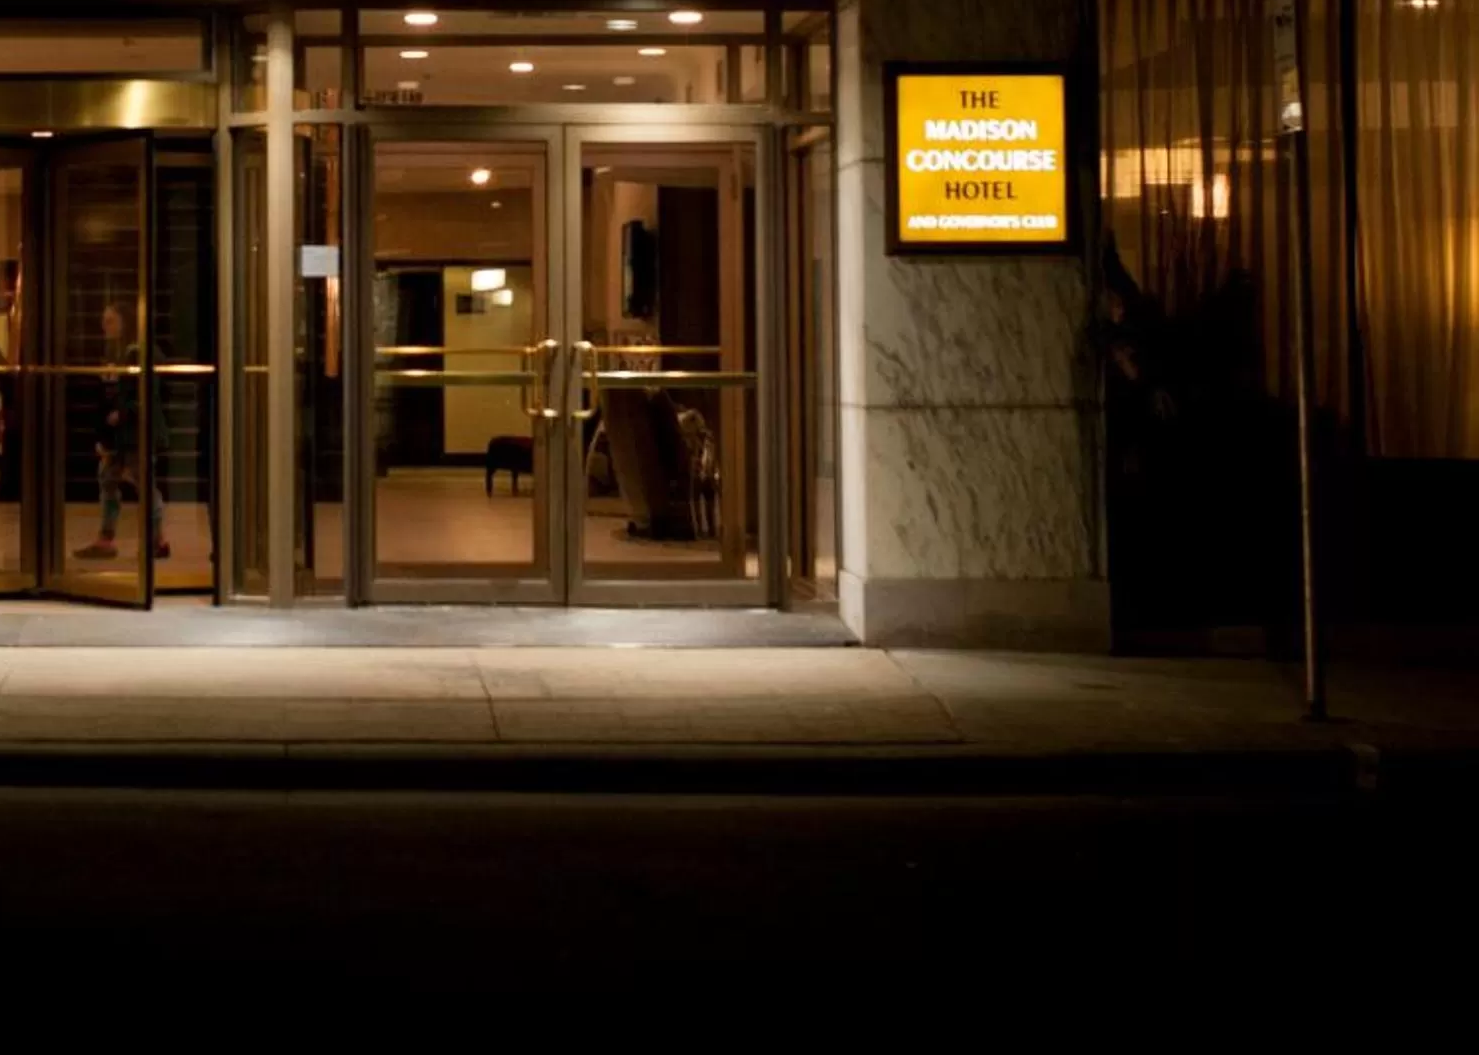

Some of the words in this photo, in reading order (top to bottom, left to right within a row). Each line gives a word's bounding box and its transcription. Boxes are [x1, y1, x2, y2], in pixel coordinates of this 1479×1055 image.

[960, 90, 999, 109] THE
[924, 120, 1037, 140] MADISON
[906, 149, 1057, 171] CONCOURSE
[945, 181, 1017, 200] HOTEL
